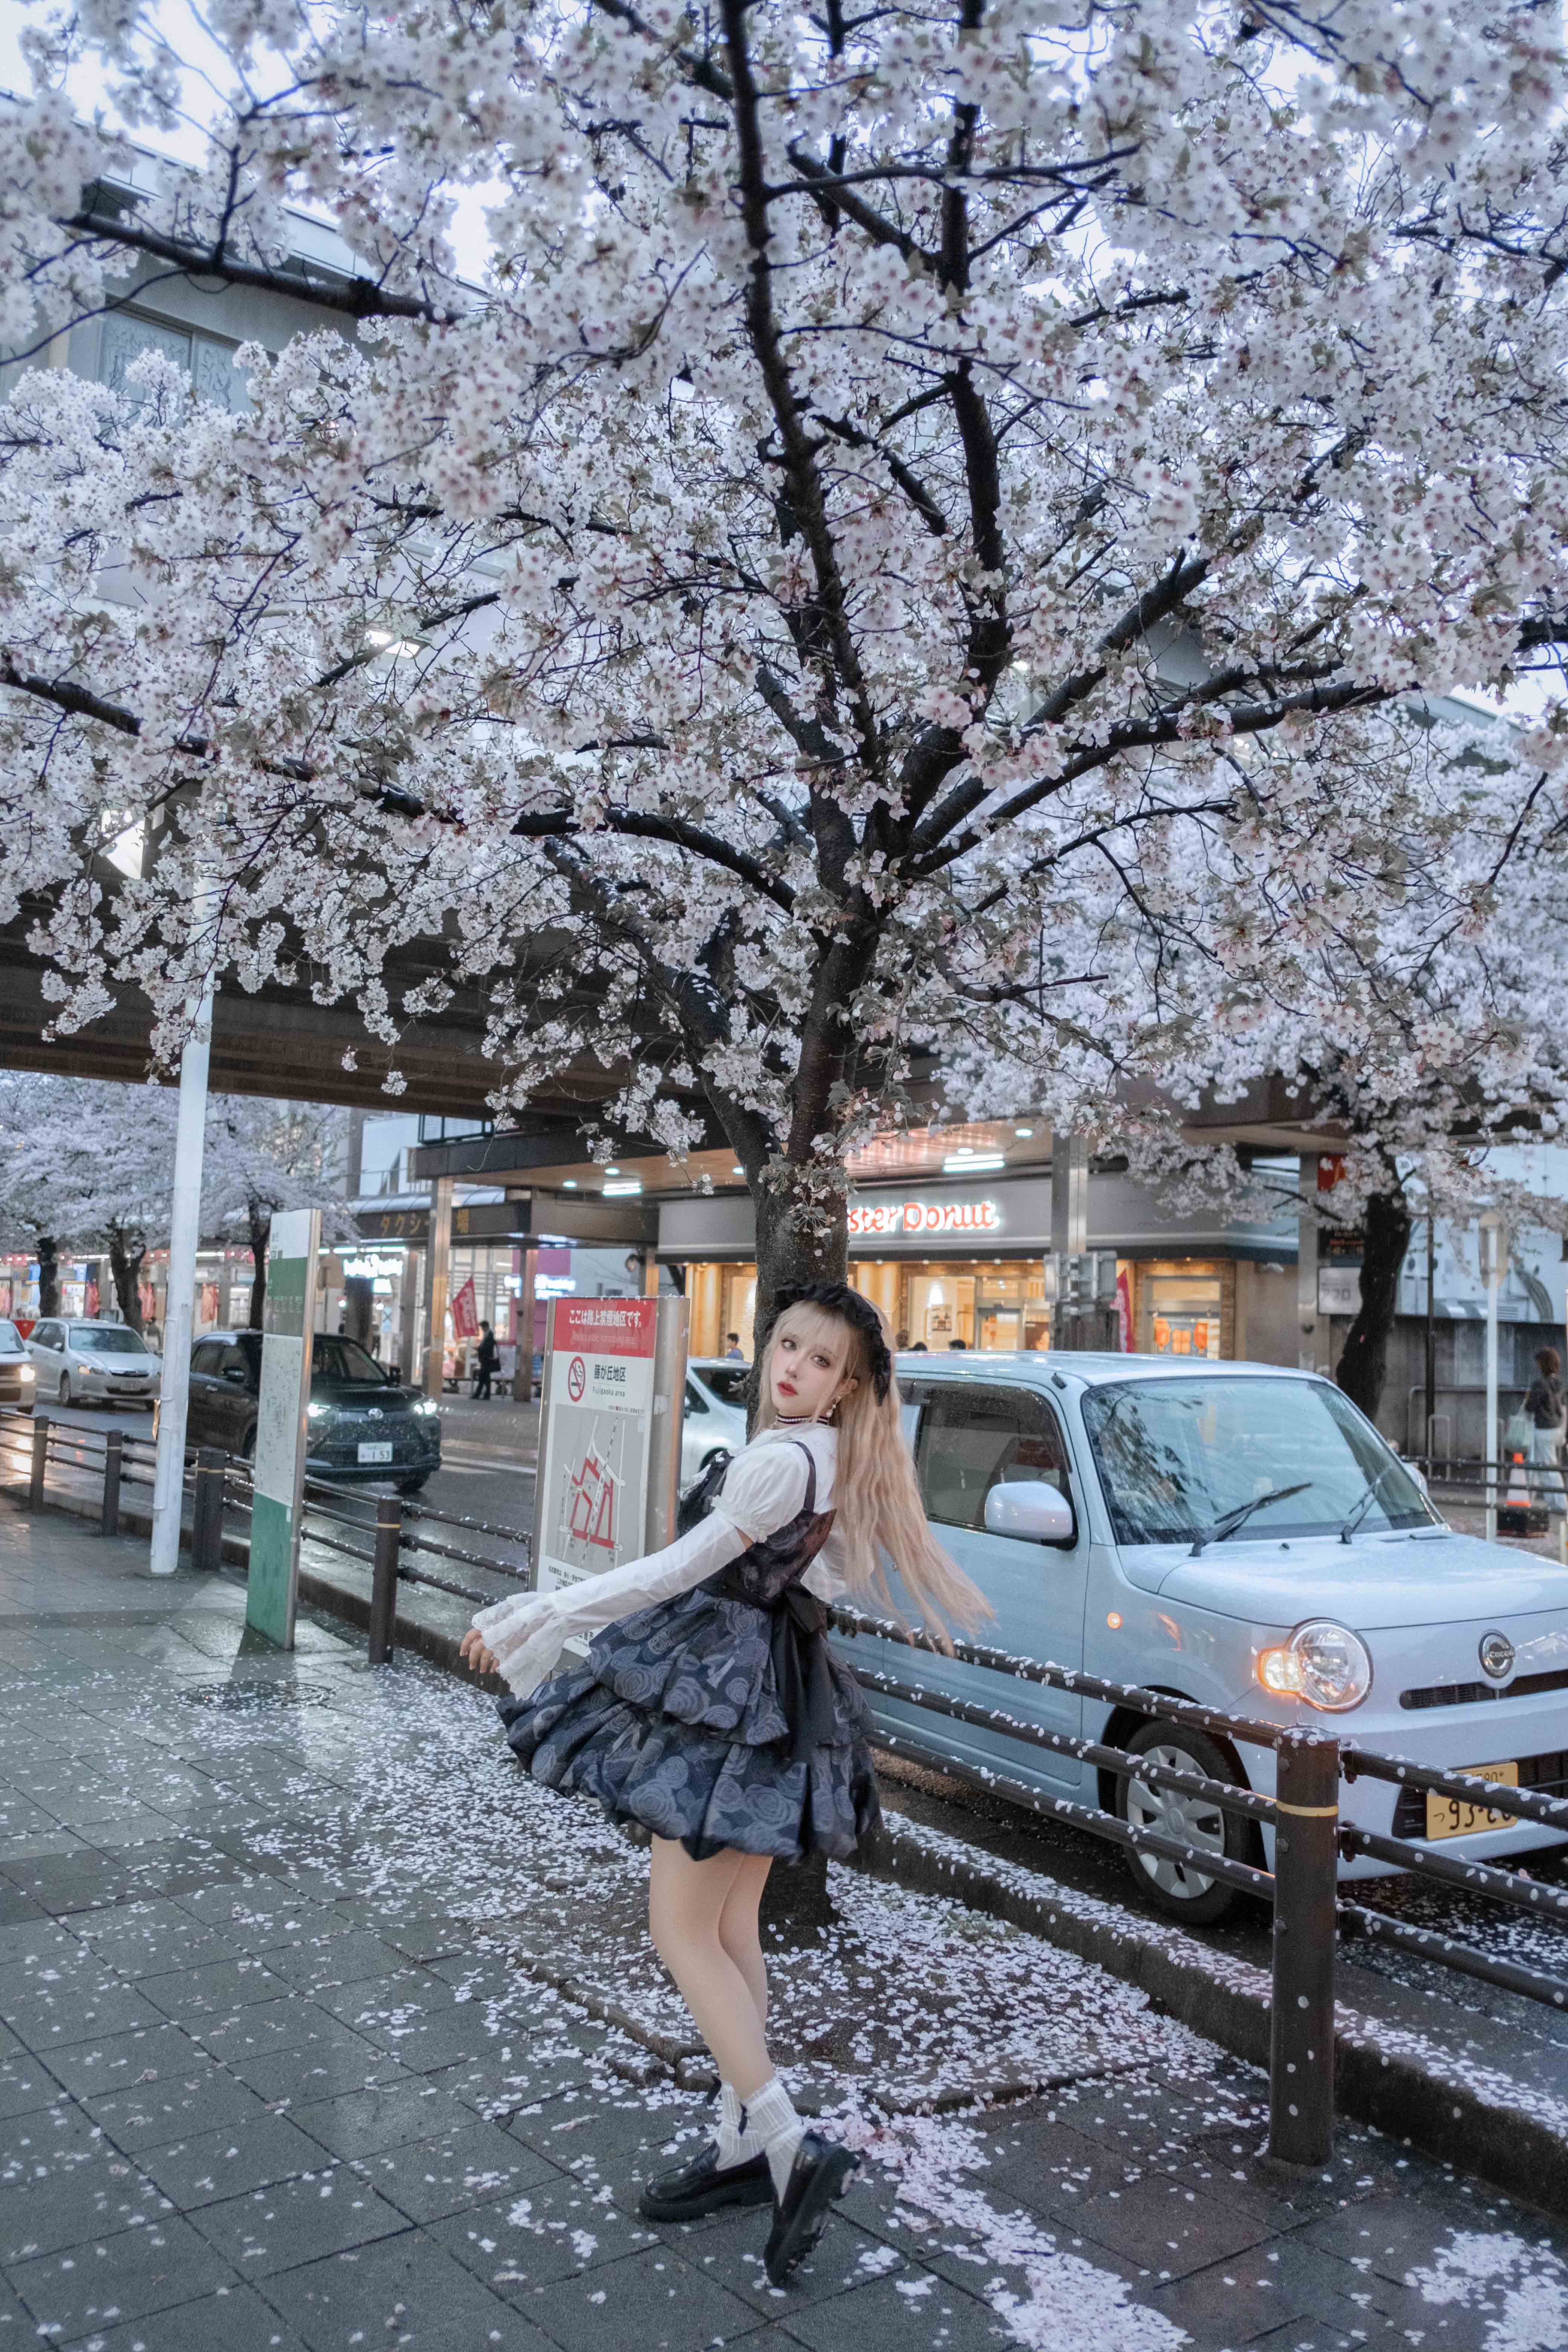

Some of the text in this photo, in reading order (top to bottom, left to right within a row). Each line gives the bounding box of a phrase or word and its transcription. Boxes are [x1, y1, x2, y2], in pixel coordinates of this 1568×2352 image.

[848, 1201, 1000, 1233] ster Donut
[1449, 1799, 1511, 1830] 93-
